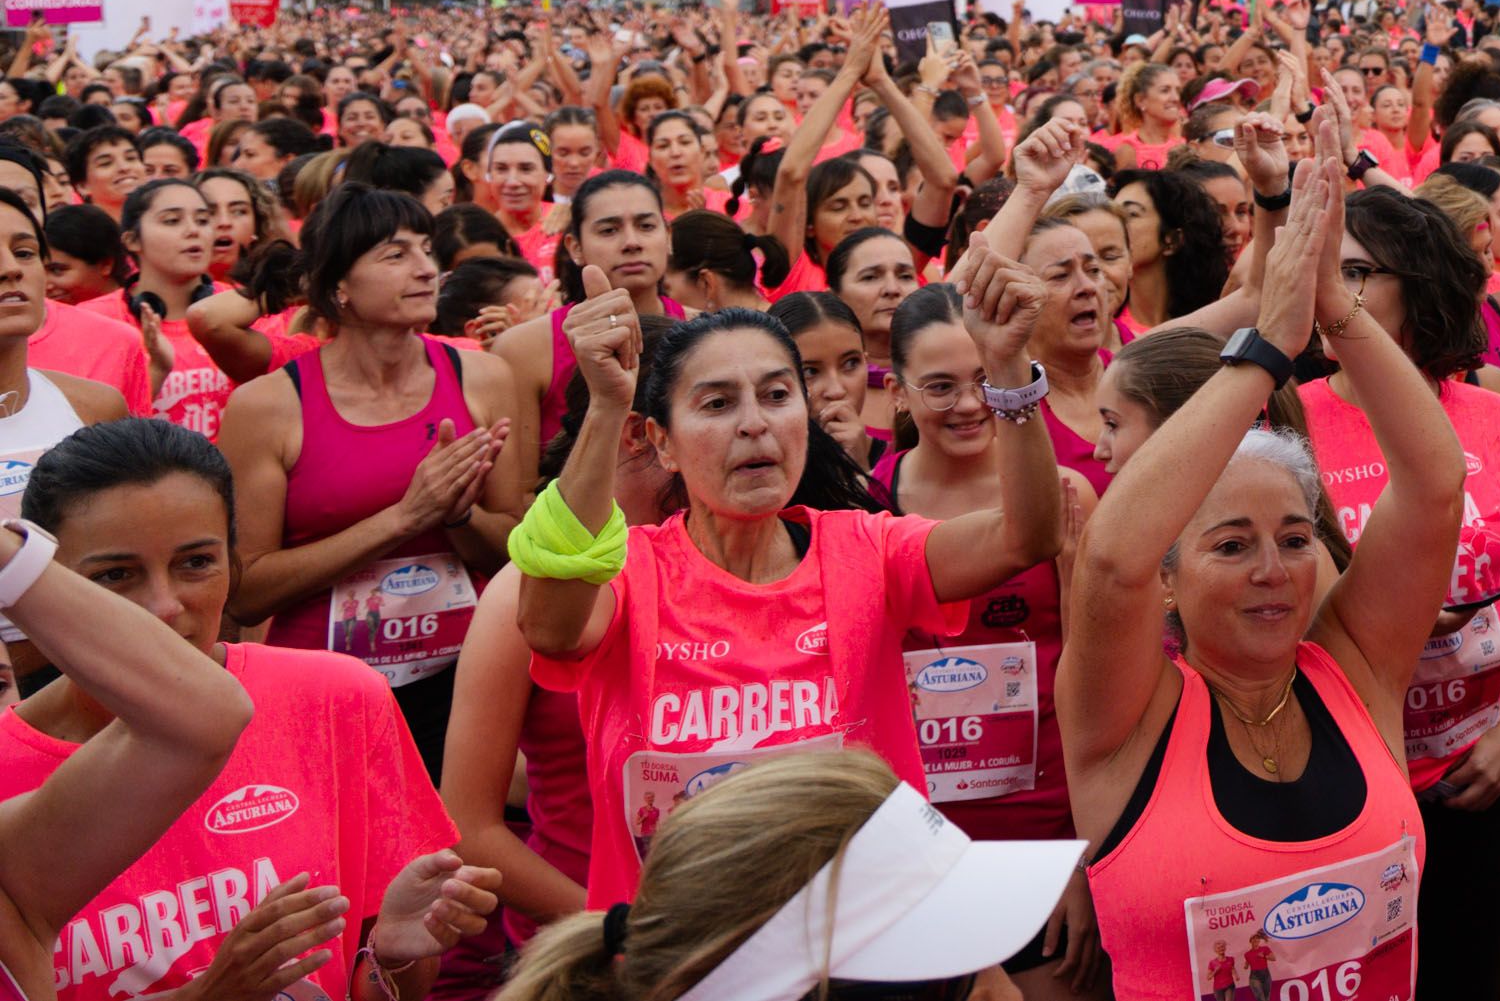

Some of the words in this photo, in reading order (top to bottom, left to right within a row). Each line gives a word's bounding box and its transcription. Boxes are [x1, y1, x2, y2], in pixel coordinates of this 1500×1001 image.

[1321, 462, 1384, 487] OYSHO
[385, 575, 436, 591] ASTURIANA
[383, 614, 438, 640] 016
[921, 671, 983, 686] ASTURIANA
[1407, 679, 1466, 710] 016
[651, 676, 839, 746] CARRERA
[920, 716, 983, 745] 016
[932, 763, 943, 772] LA
[945, 758, 973, 771] MUJER
[642, 770, 680, 784] SUMA
[970, 775, 1018, 789] Santander
[214, 799, 294, 829] ASTURIANA
[1205, 908, 1217, 917] TU
[1219, 901, 1254, 915] DORSAL
[1208, 910, 1255, 931] SUMA
[1272, 897, 1359, 934] ASTURIANA
